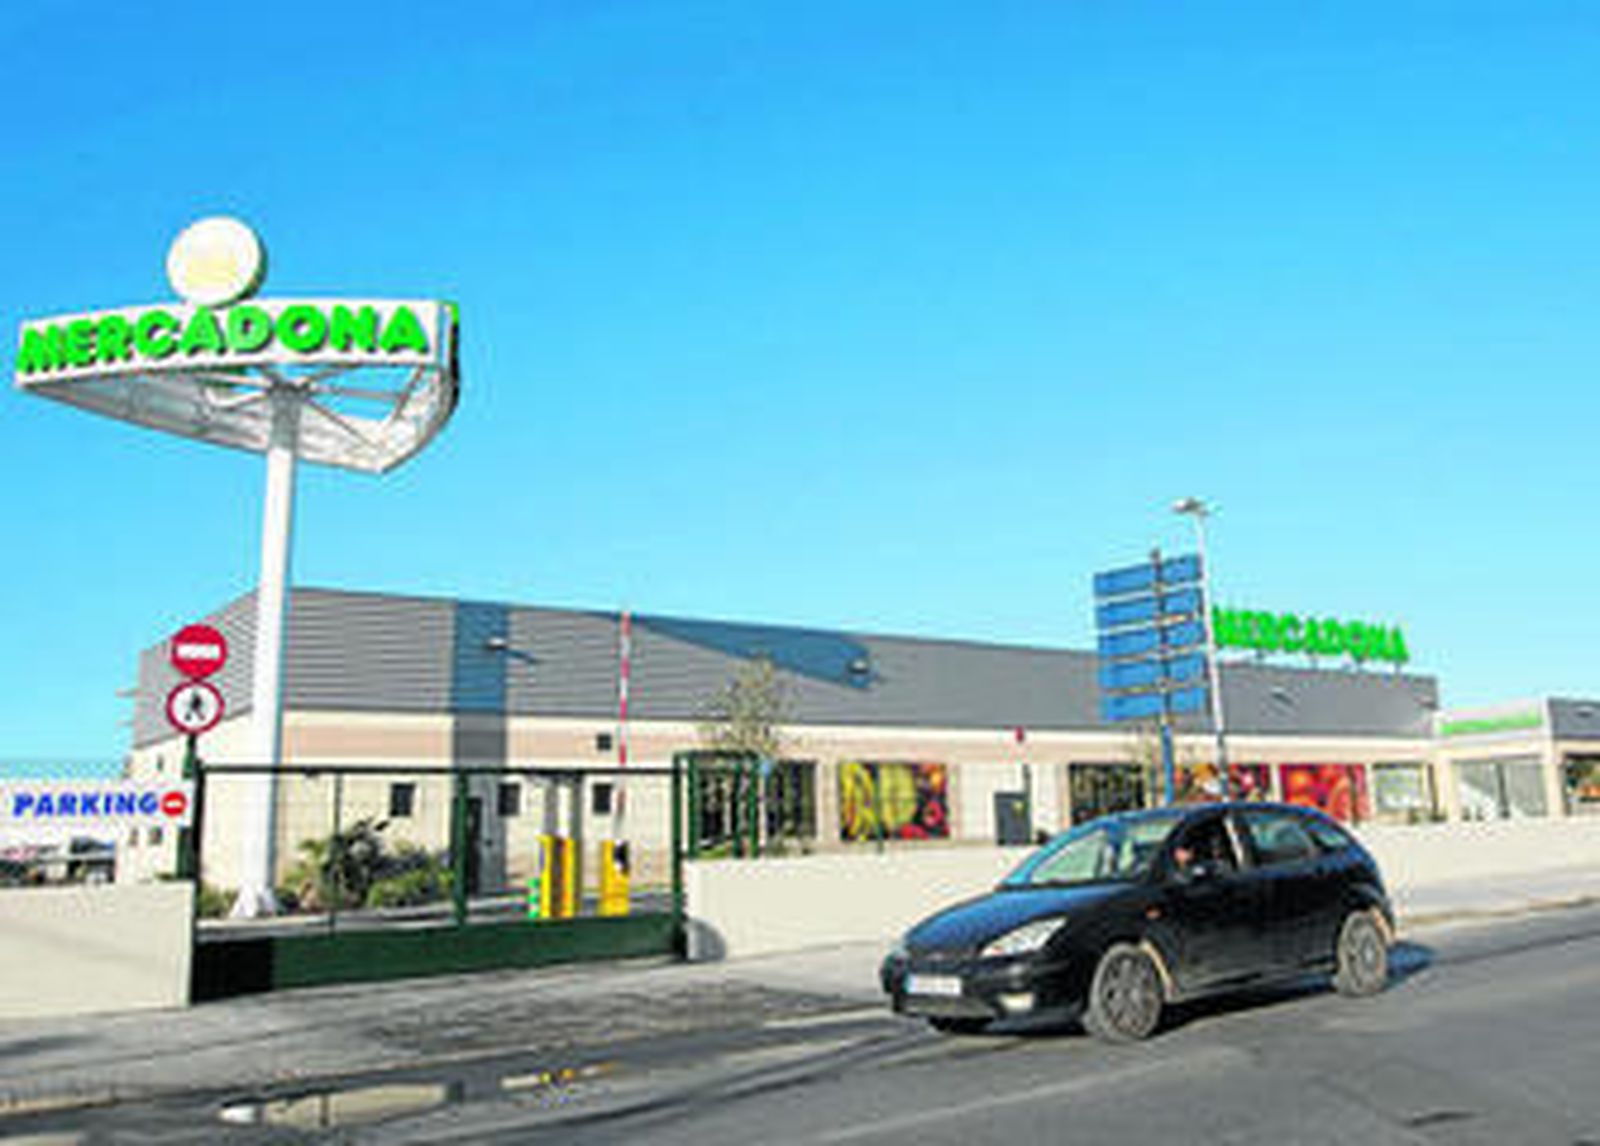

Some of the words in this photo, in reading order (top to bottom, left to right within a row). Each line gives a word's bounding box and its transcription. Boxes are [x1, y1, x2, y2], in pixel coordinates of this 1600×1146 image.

[16, 303, 429, 376] MERCADONA
[1212, 605, 1409, 662] MERCADONA
[13, 791, 159, 816] PARKING
